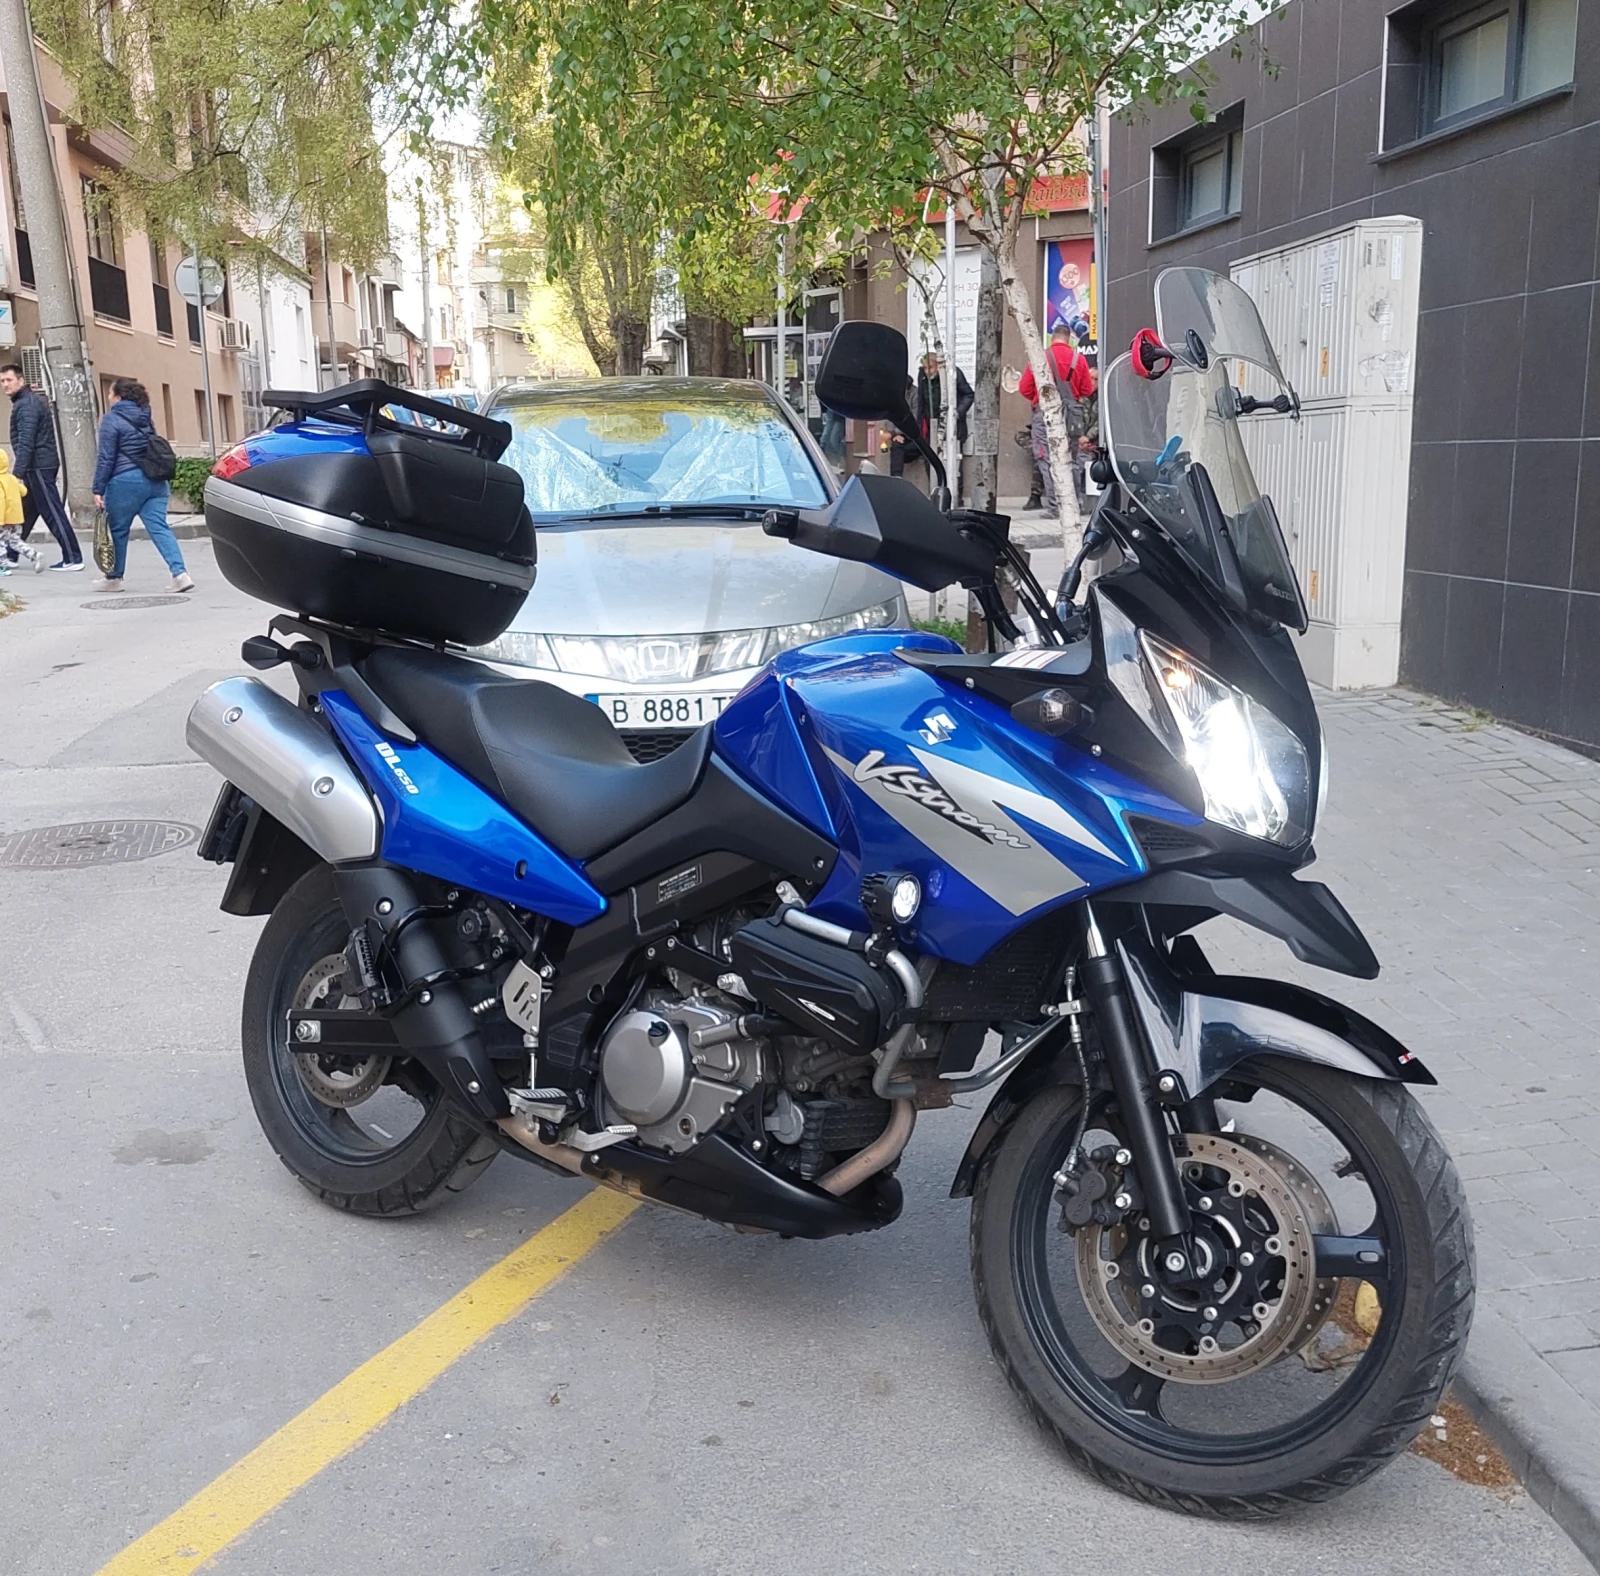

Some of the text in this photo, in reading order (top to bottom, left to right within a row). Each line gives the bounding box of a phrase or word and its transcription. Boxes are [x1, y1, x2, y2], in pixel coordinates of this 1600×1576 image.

[612, 696, 736, 723] B 8881 T
[374, 741, 419, 795] DL650
